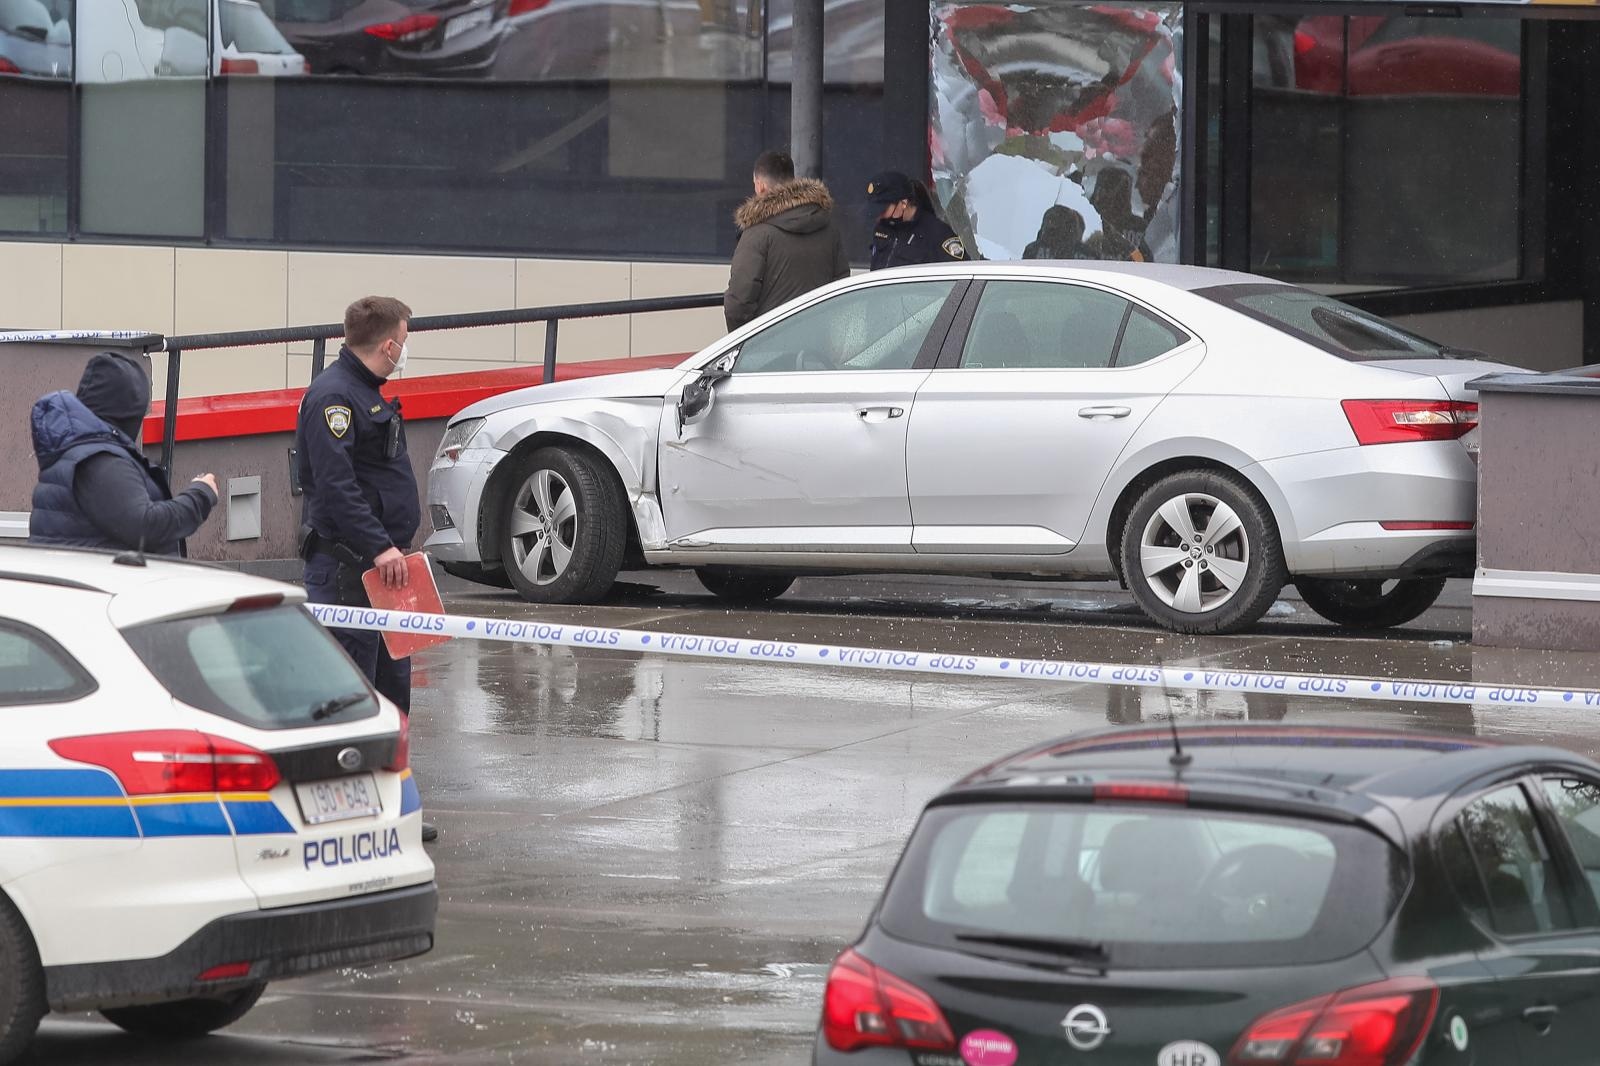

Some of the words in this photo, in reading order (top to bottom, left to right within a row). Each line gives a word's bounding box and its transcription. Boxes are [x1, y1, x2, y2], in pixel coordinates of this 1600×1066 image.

[311, 605, 390, 627] POLICIJA
[399, 613, 445, 631] STOP
[485, 620, 563, 641] POLICIJA
[573, 628, 620, 645] STOP
[660, 635, 740, 654] POLICIJA
[750, 642, 798, 658] STOP
[839, 648, 919, 667] POLICIJA
[929, 654, 978, 671] STOP
[1020, 661, 1101, 679] POLICIJA
[1112, 667, 1161, 683] STOP
[1298, 678, 1349, 693] STOP
[303, 827, 403, 871] POLICIJA
[1171, 1052, 1207, 1066] HR
